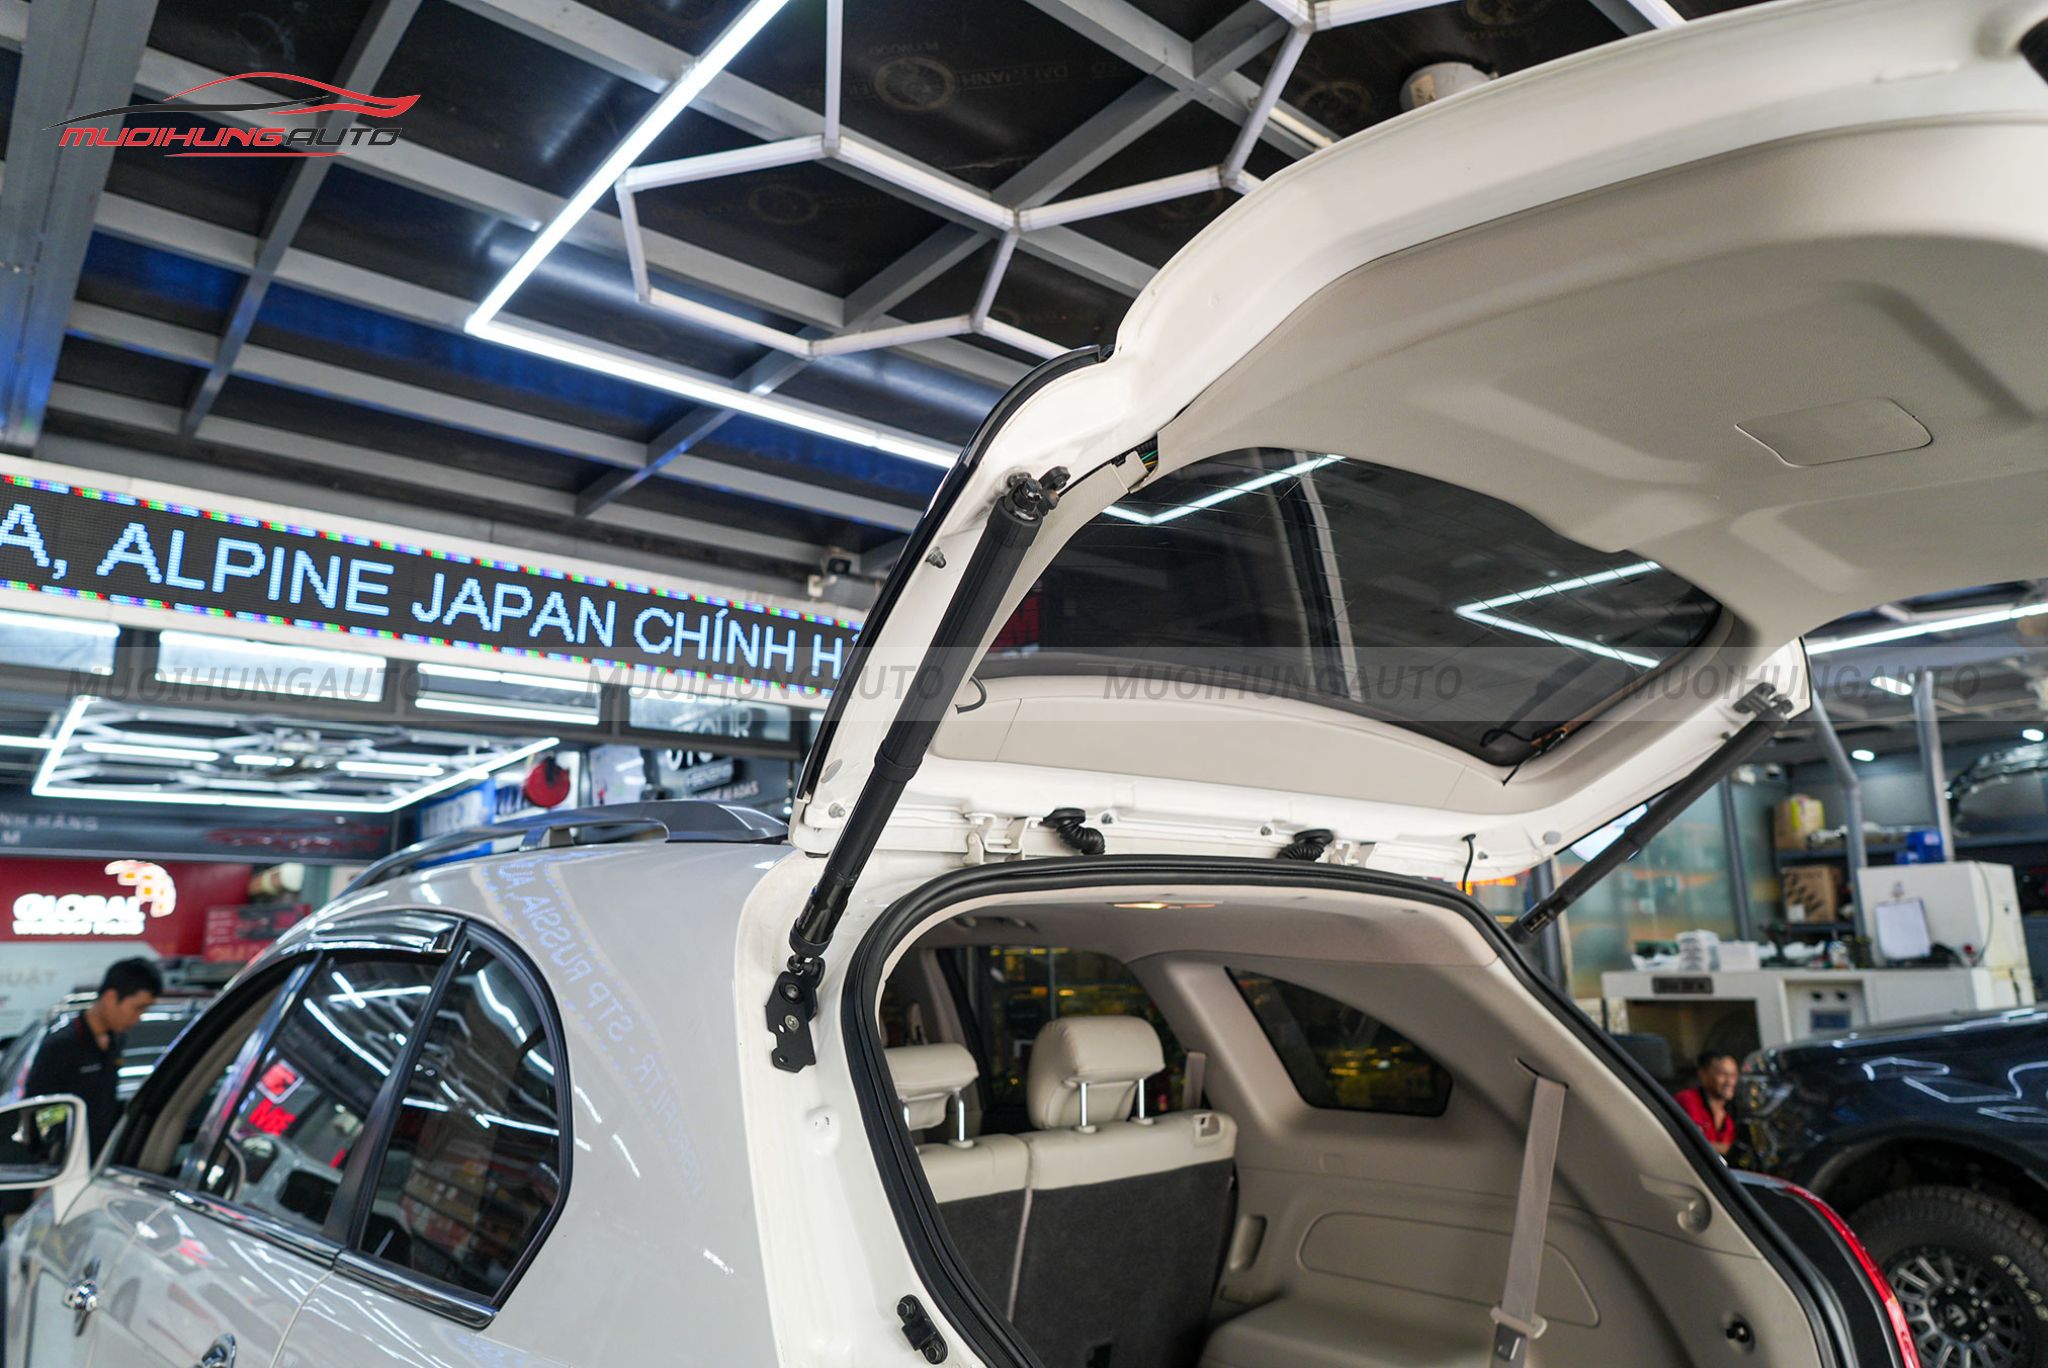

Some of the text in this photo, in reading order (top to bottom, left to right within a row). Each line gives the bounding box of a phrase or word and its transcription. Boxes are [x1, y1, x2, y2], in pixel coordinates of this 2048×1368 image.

[97, 522, 394, 617] ALPINE
[411, 571, 617, 648] JAPAN
[633, 606, 797, 673] CHÍNH
[811, 633, 860, 680] H
